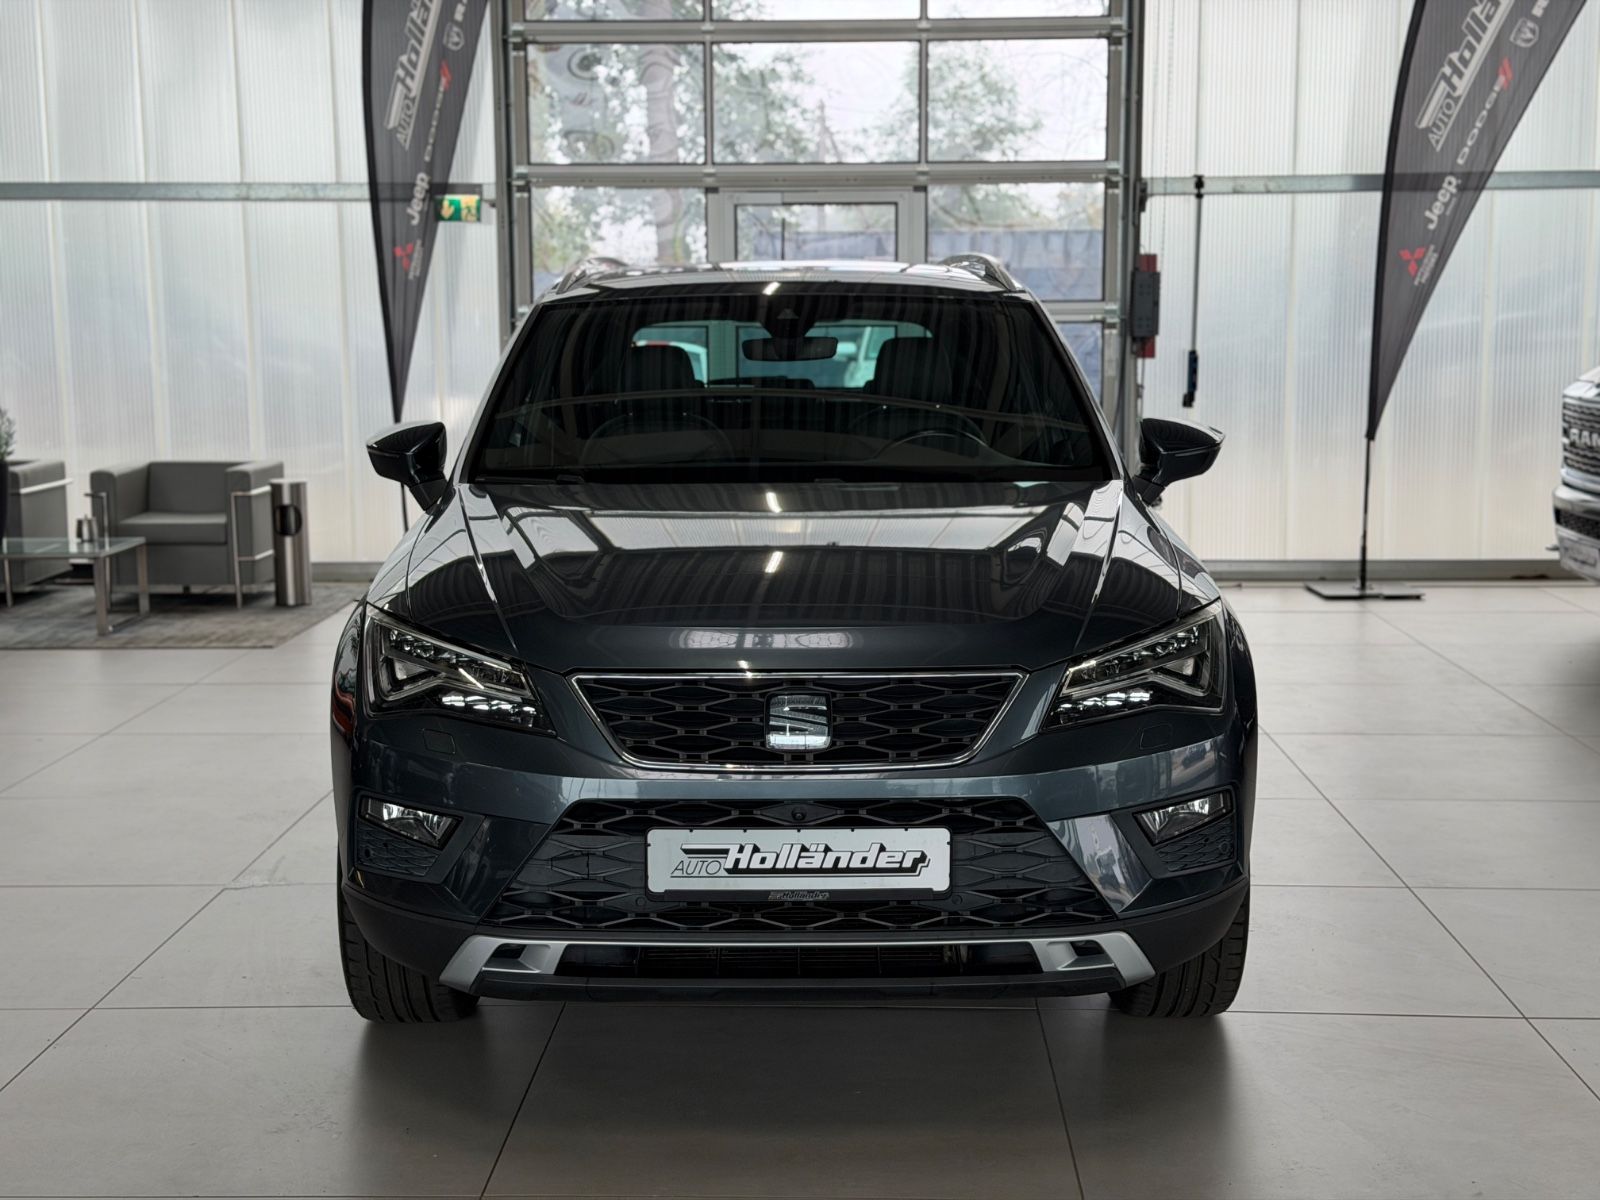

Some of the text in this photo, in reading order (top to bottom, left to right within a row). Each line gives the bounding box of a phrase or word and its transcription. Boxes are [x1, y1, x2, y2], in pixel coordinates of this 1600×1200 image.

[1427, 97, 1456, 147] AUTO
[1456, 74, 1507, 165] DODGE
[406, 172, 430, 226] Jeep
[1424, 175, 1457, 230] Jeep
[671, 842, 928, 875] AUTO Holländer
